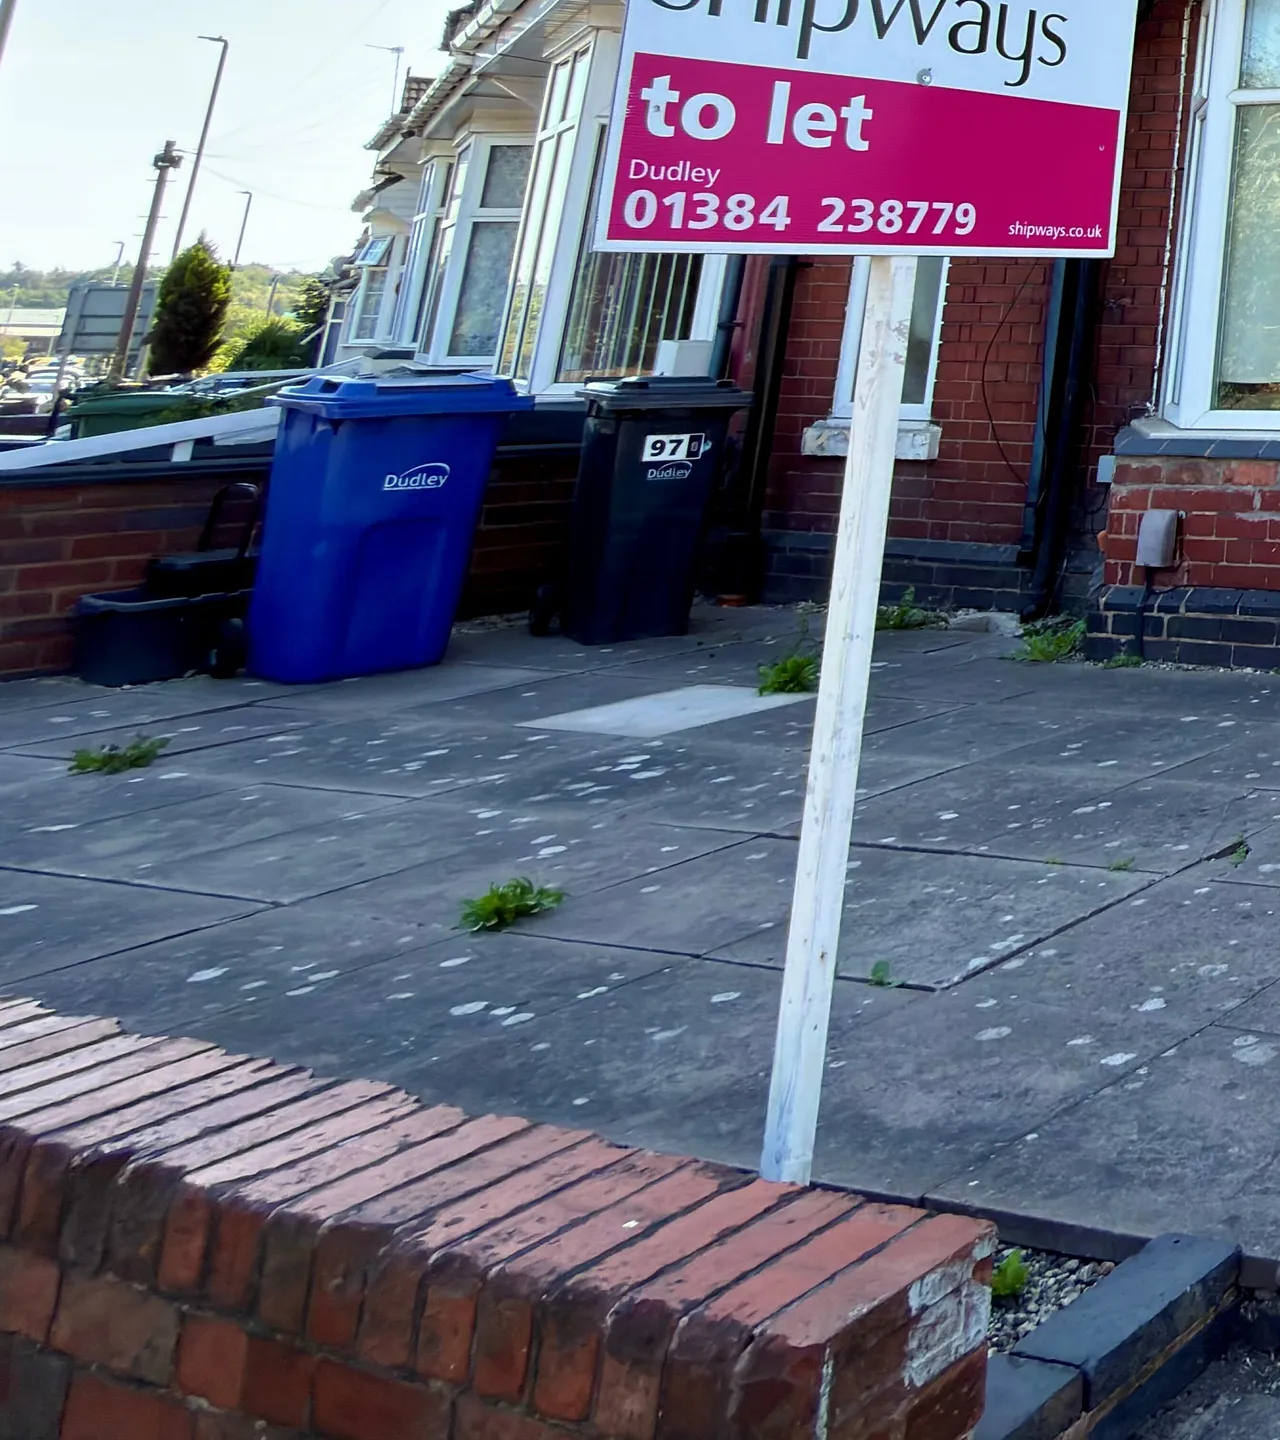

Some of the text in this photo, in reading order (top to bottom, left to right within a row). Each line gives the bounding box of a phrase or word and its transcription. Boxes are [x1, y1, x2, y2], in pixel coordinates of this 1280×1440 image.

[640, 74, 874, 152] to let
[628, 159, 721, 187] Dudley
[623, 189, 977, 236] 01384 238779
[1008, 220, 1103, 240] shipways.co.uk
[650, 439, 684, 457] 97
[384, 472, 449, 489] Dudley
[647, 468, 691, 479] Dudley
